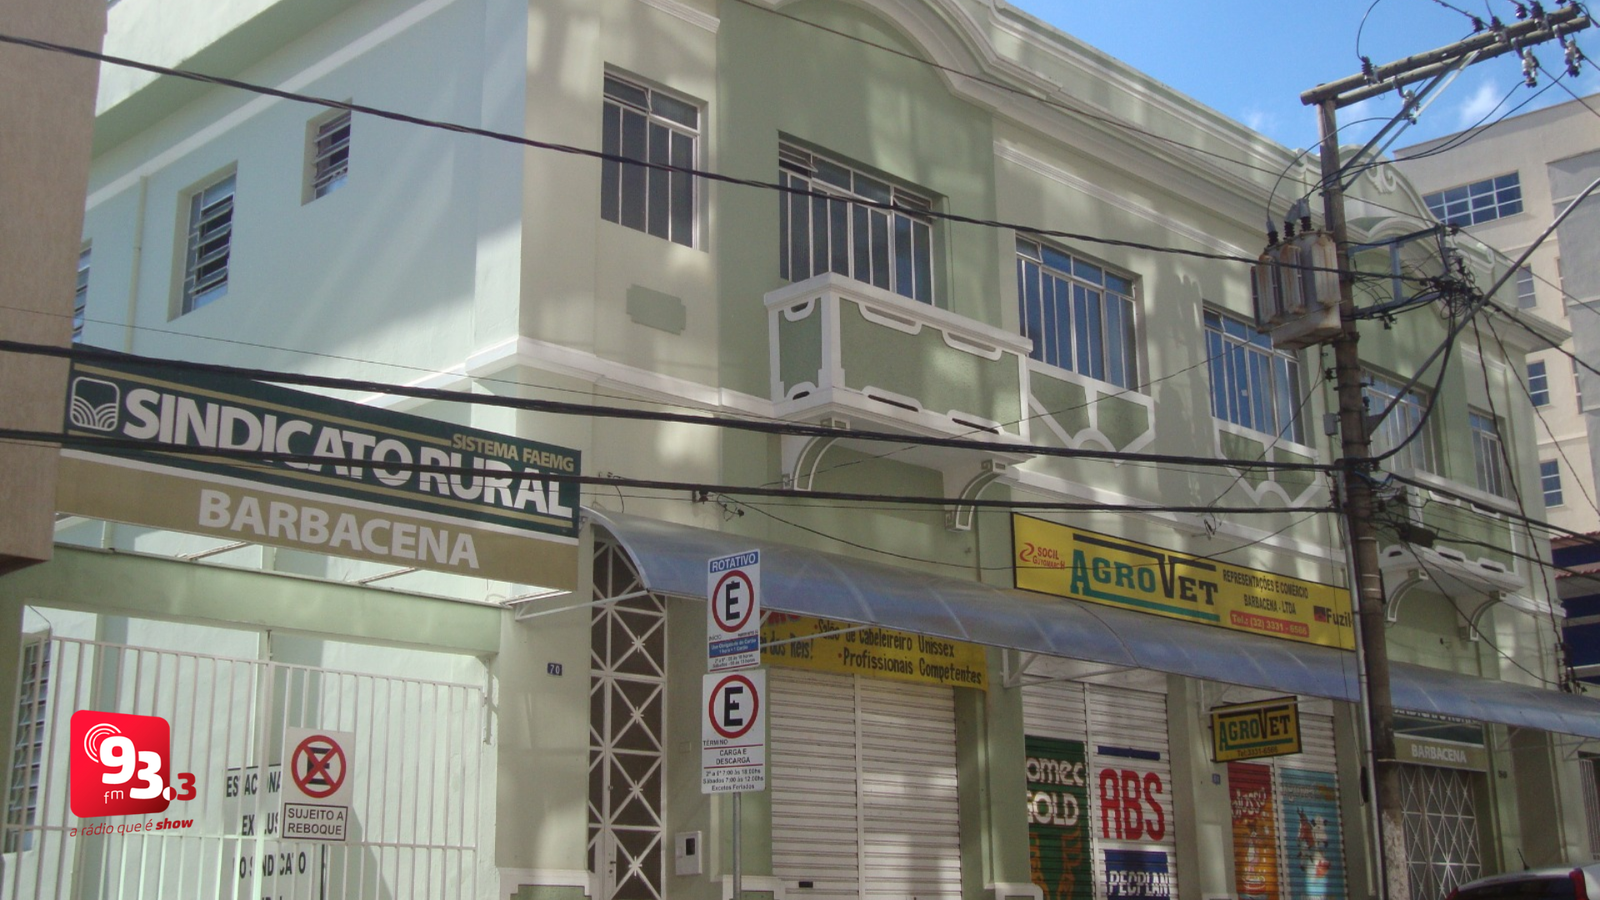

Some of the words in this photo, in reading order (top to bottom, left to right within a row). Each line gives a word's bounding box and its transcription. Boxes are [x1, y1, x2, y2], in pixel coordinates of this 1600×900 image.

[123, 388, 414, 486] SINDICATO
[419, 445, 573, 519] RURAL
[453, 433, 519, 461] SISTEMA
[522, 447, 574, 472] FAEMG
[198, 489, 480, 569] BARBACENA
[712, 553, 756, 572] ROTATIVO
[1037, 547, 1059, 560] SOCIL
[1223, 569, 1275, 592] REPRESENTAÇÕES
[1275, 581, 1280, 593] E
[1280, 582, 1309, 599] COMÉRCIO
[726, 582, 740, 621] E
[1243, 594, 1278, 612] BARBACENA
[1281, 601, 1296, 615] LTDA
[1250, 617, 1265, 629] (32)
[1266, 620, 1284, 631] 3331
[845, 622, 856, 643] de
[858, 625, 912, 651] Cabeleireiro
[918, 634, 954, 658] Unissex
[550, 664, 561, 675] 70
[843, 647, 913, 675] Profissionais
[919, 657, 982, 684] Competentes
[724, 686, 743, 727] E
[716, 756, 751, 765] DESCARGA
[719, 748, 741, 757] CARGA
[1411, 744, 1467, 763] BARBACENA
[288, 808, 335, 820] SUJEITO
[336, 811, 344, 821] A
[1099, 768, 1166, 841] ABS
[288, 822, 342, 836] REBOQUE
[1108, 870, 1170, 897] PECPLAN
